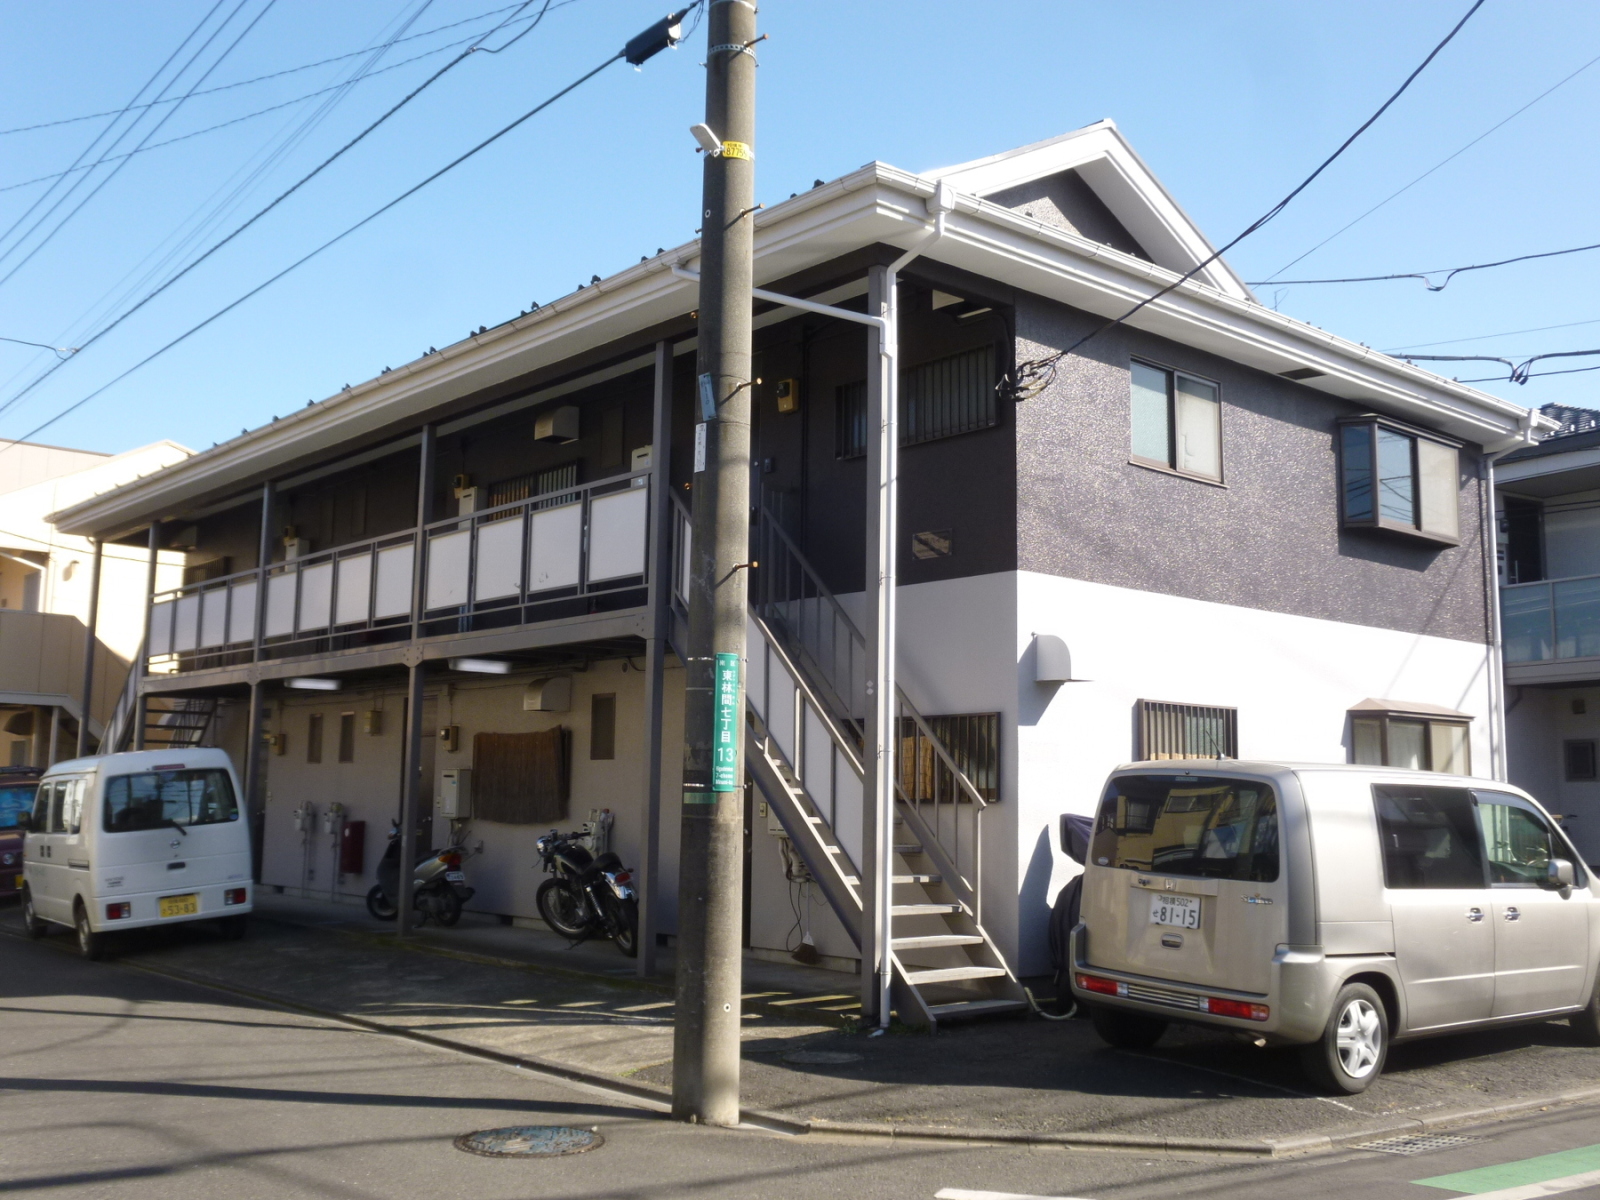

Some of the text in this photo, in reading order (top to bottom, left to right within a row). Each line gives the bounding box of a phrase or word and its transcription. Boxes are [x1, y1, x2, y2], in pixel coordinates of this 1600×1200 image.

[721, 670, 733, 743] 東林間七丁目
[717, 747, 734, 762] 13
[1160, 906, 1197, 926] 81-15
